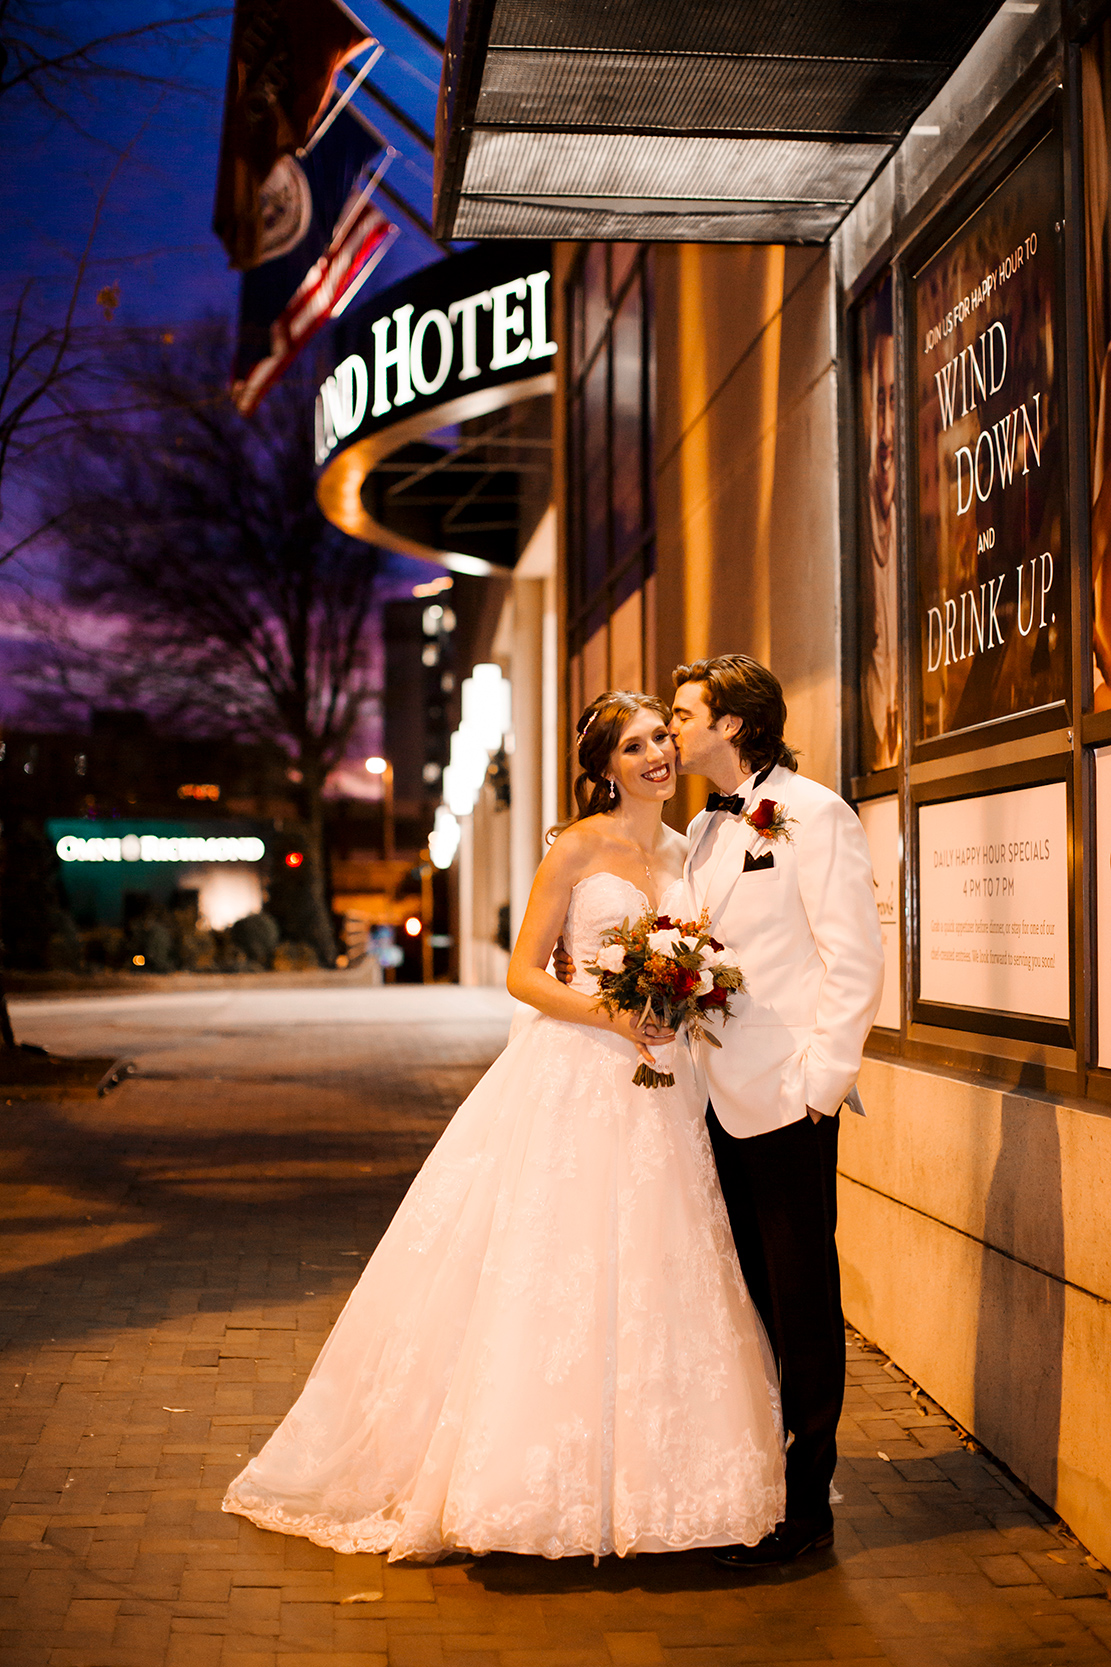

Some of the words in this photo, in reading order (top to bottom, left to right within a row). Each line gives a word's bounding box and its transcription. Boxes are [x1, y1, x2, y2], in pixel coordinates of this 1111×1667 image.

[924, 321, 942, 354] JOIN
[942, 311, 953, 337] US
[953, 296, 971, 328] FOR
[971, 269, 998, 312] HAPPY
[999, 245, 1024, 286] HOUR
[1024, 232, 1038, 260] TO
[371, 270, 558, 417] HOTEL
[934, 321, 1007, 432] WIND
[954, 392, 1041, 517] DOWN
[977, 527, 996, 555] AND
[927, 573, 1006, 673] DRINK
[1016, 551, 1056, 637] UP.
[934, 849, 954, 868] DAILY
[955, 846, 980, 867] HAPPY
[982, 843, 1006, 865] HOUR
[1008, 838, 1050, 863] SPECIALS
[962, 879, 968, 897] 4
[969, 878, 981, 897] PM
[982, 877, 994, 897] TO
[995, 876, 1001, 897] 7
[1002, 876, 1015, 897] PM
[1011, 922, 1021, 938] stay
[1021, 919, 1030, 934] for
[1030, 924, 1039, 935] one
[1040, 919, 1046, 935] of
[1046, 924, 1055, 935] our
[1013, 951, 1031, 971] serving
[1031, 956, 1041, 971] you
[1041, 953, 1055, 968] soon!
